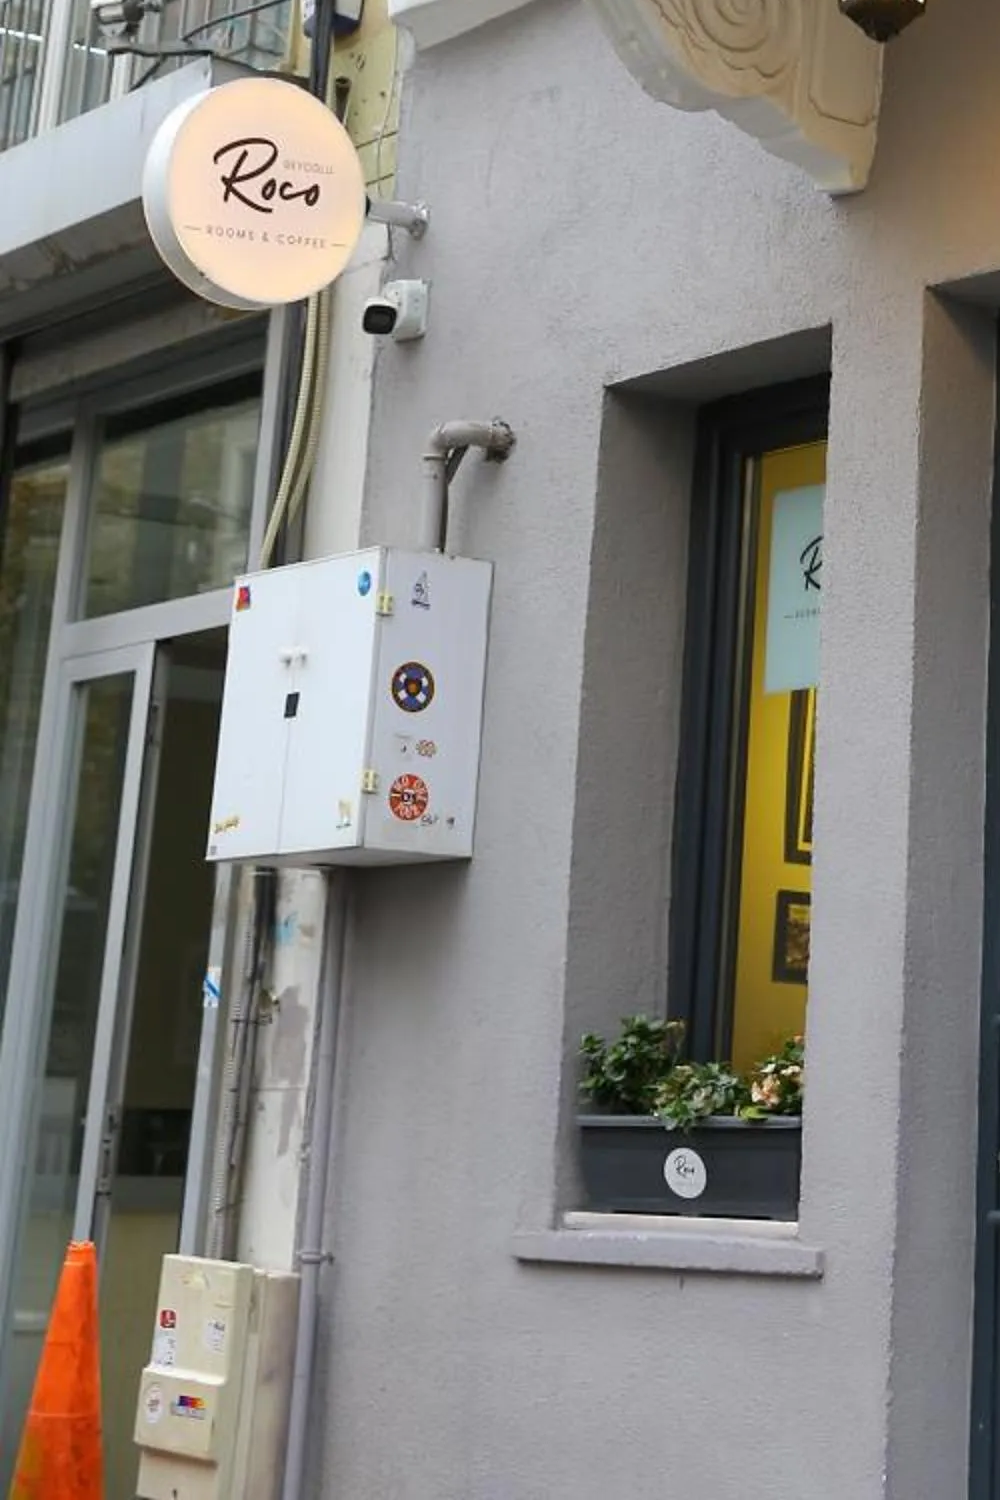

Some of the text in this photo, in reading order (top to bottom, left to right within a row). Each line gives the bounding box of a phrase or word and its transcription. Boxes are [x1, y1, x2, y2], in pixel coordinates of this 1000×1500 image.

[213, 137, 320, 213] Roco
[205, 225, 326, 249] ROOMS & COFFEE
